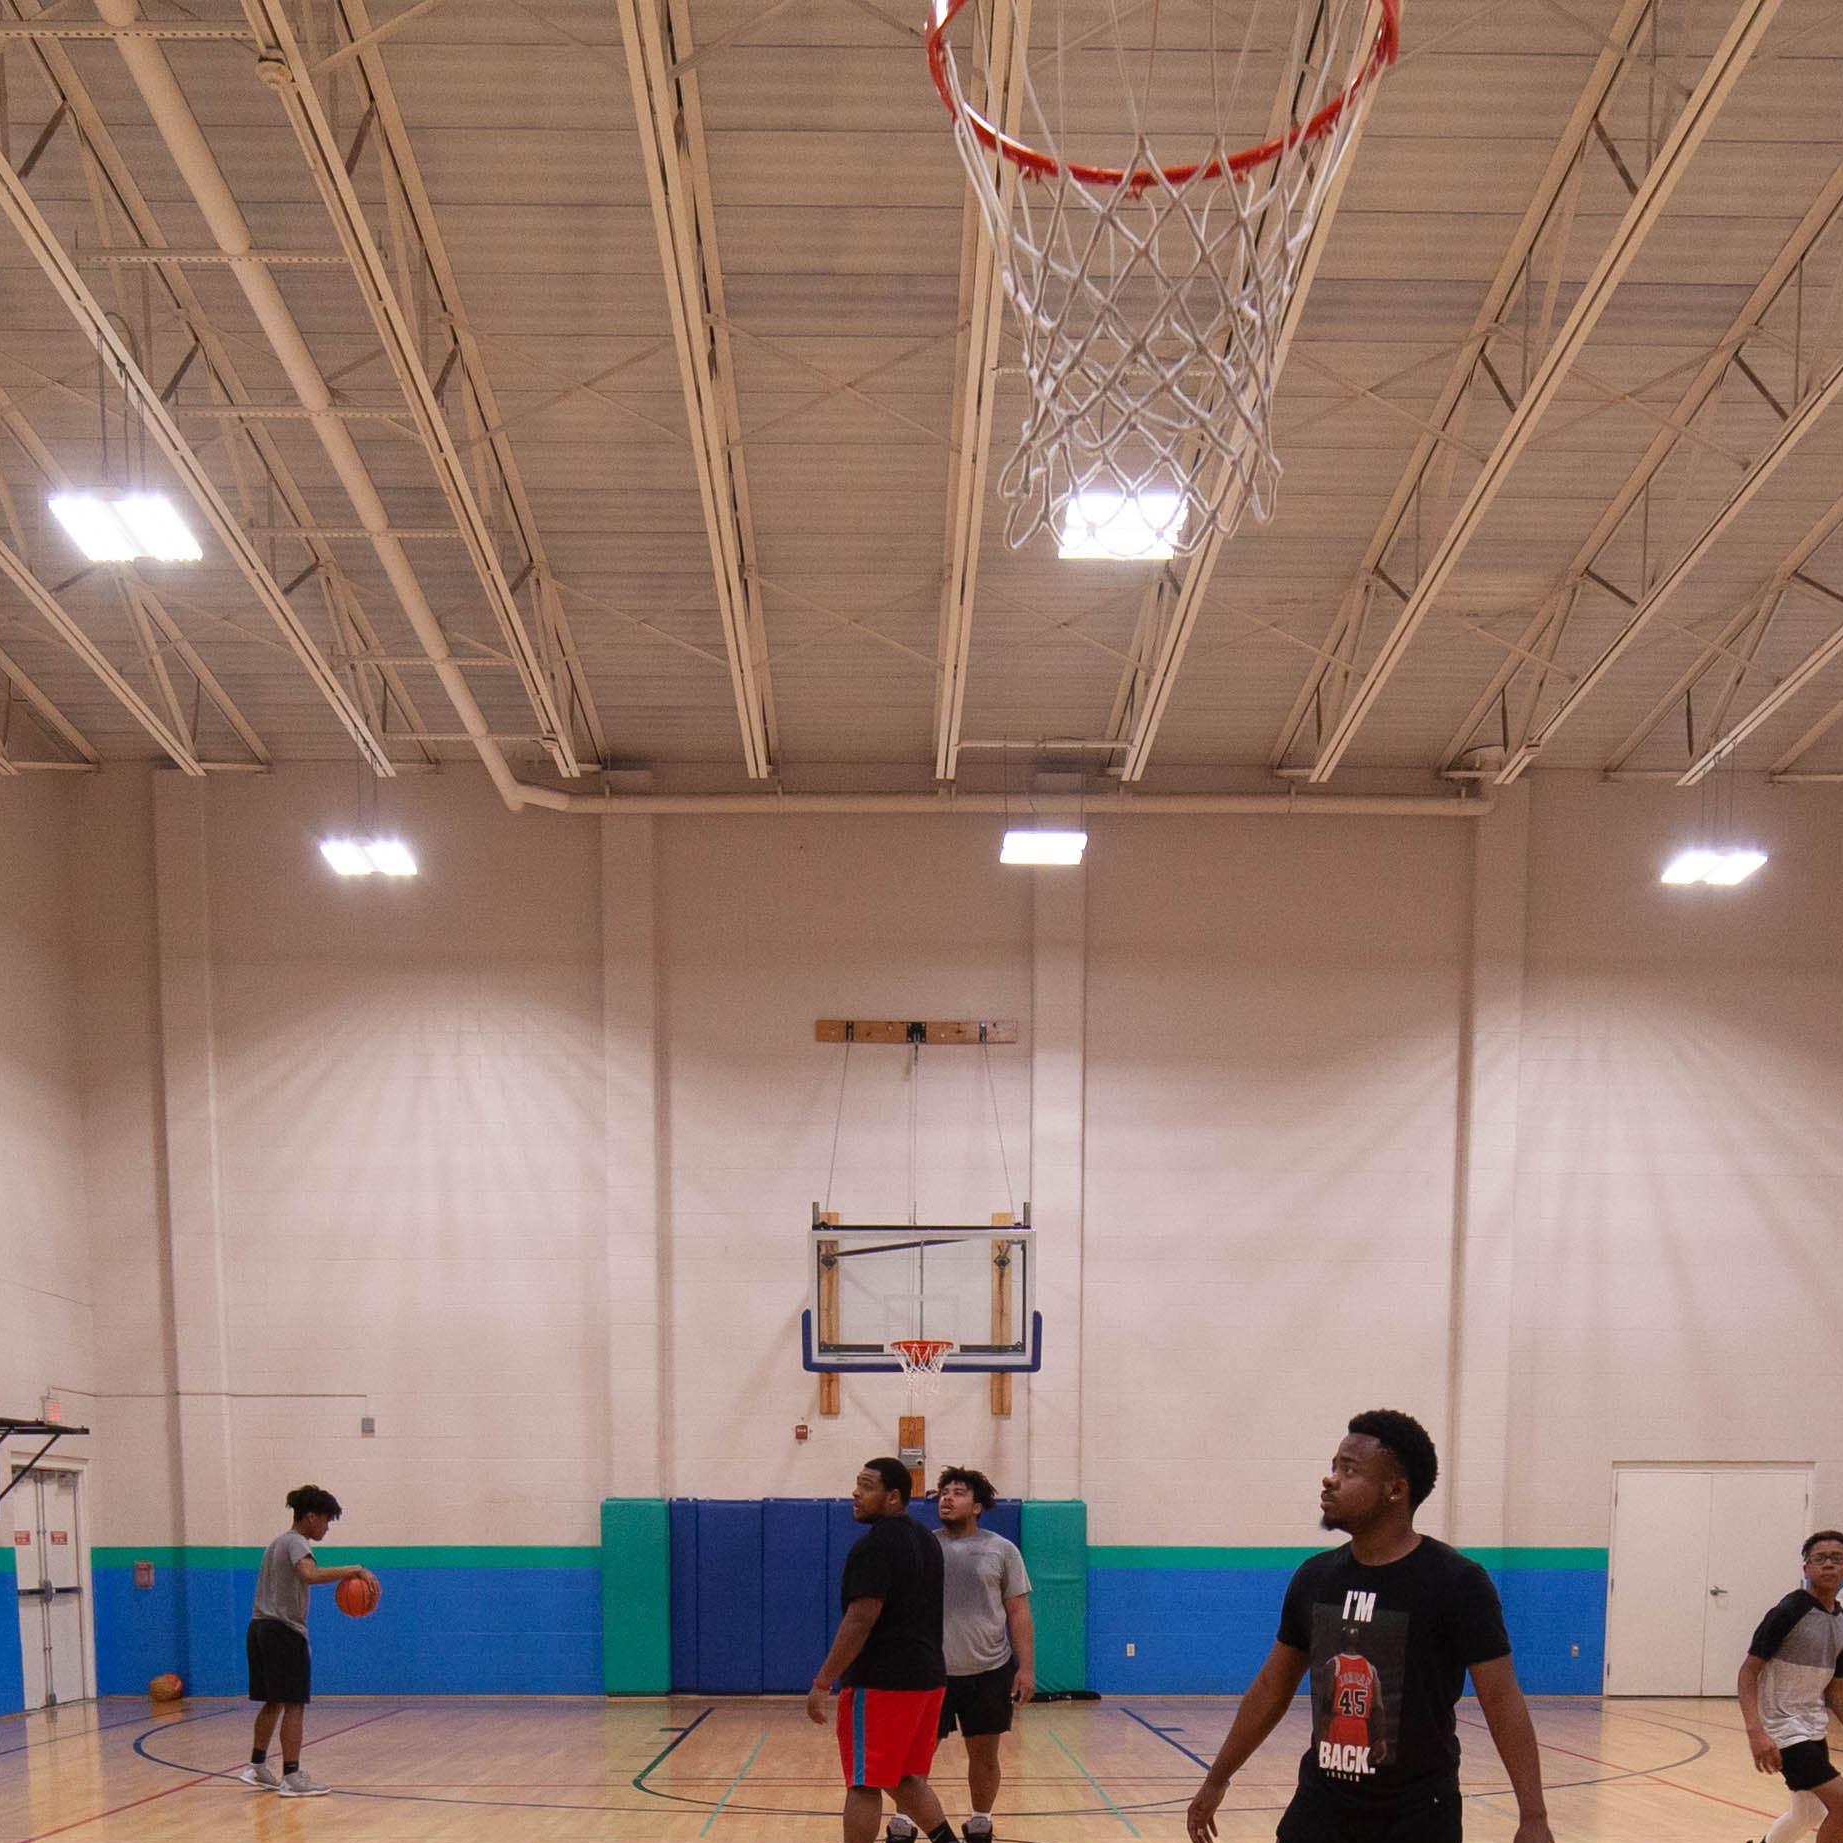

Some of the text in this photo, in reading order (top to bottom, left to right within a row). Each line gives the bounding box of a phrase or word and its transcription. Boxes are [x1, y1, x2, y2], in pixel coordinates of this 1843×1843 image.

[1342, 1590, 1377, 1622] I'M
[1338, 1688, 1368, 1718] 45
[1319, 1740, 1376, 1774] BACK.
